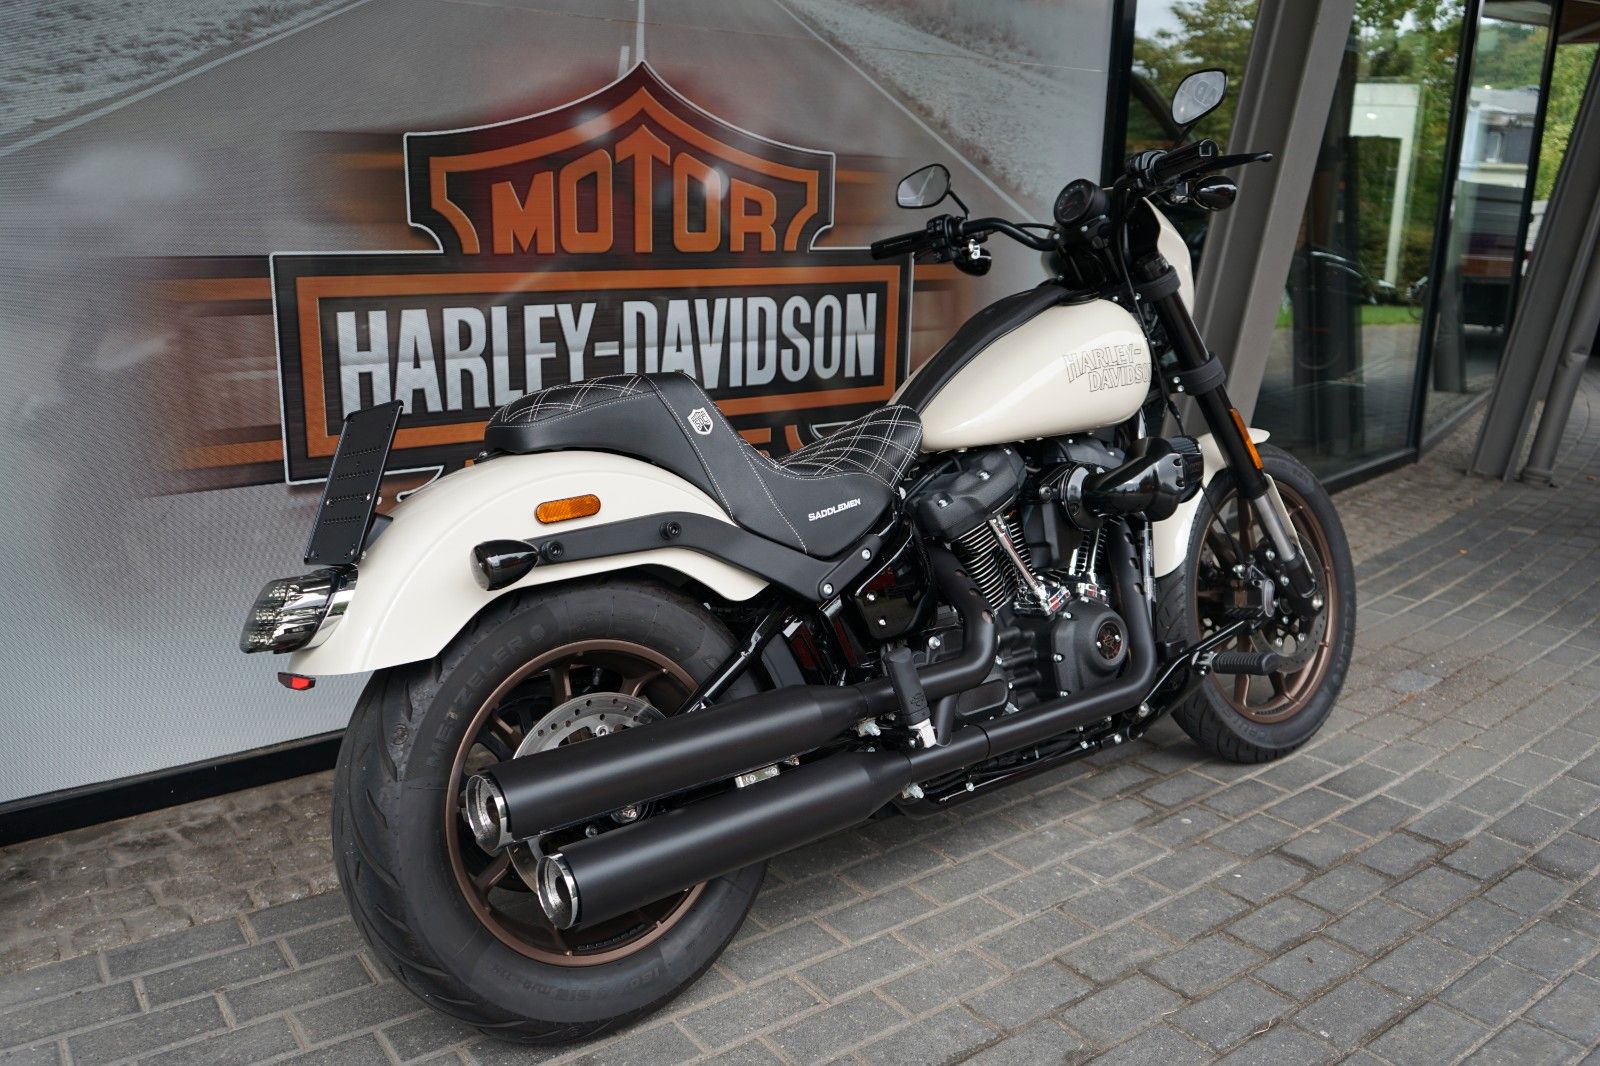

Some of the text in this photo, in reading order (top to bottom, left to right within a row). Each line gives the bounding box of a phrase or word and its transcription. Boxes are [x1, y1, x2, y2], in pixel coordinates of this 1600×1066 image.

[492, 124, 777, 255] MOTOR
[336, 293, 877, 419] HARLEY-DAVIDSON
[1063, 344, 1141, 383] HARLEY-
[808, 498, 861, 522] SADDLEMEN
